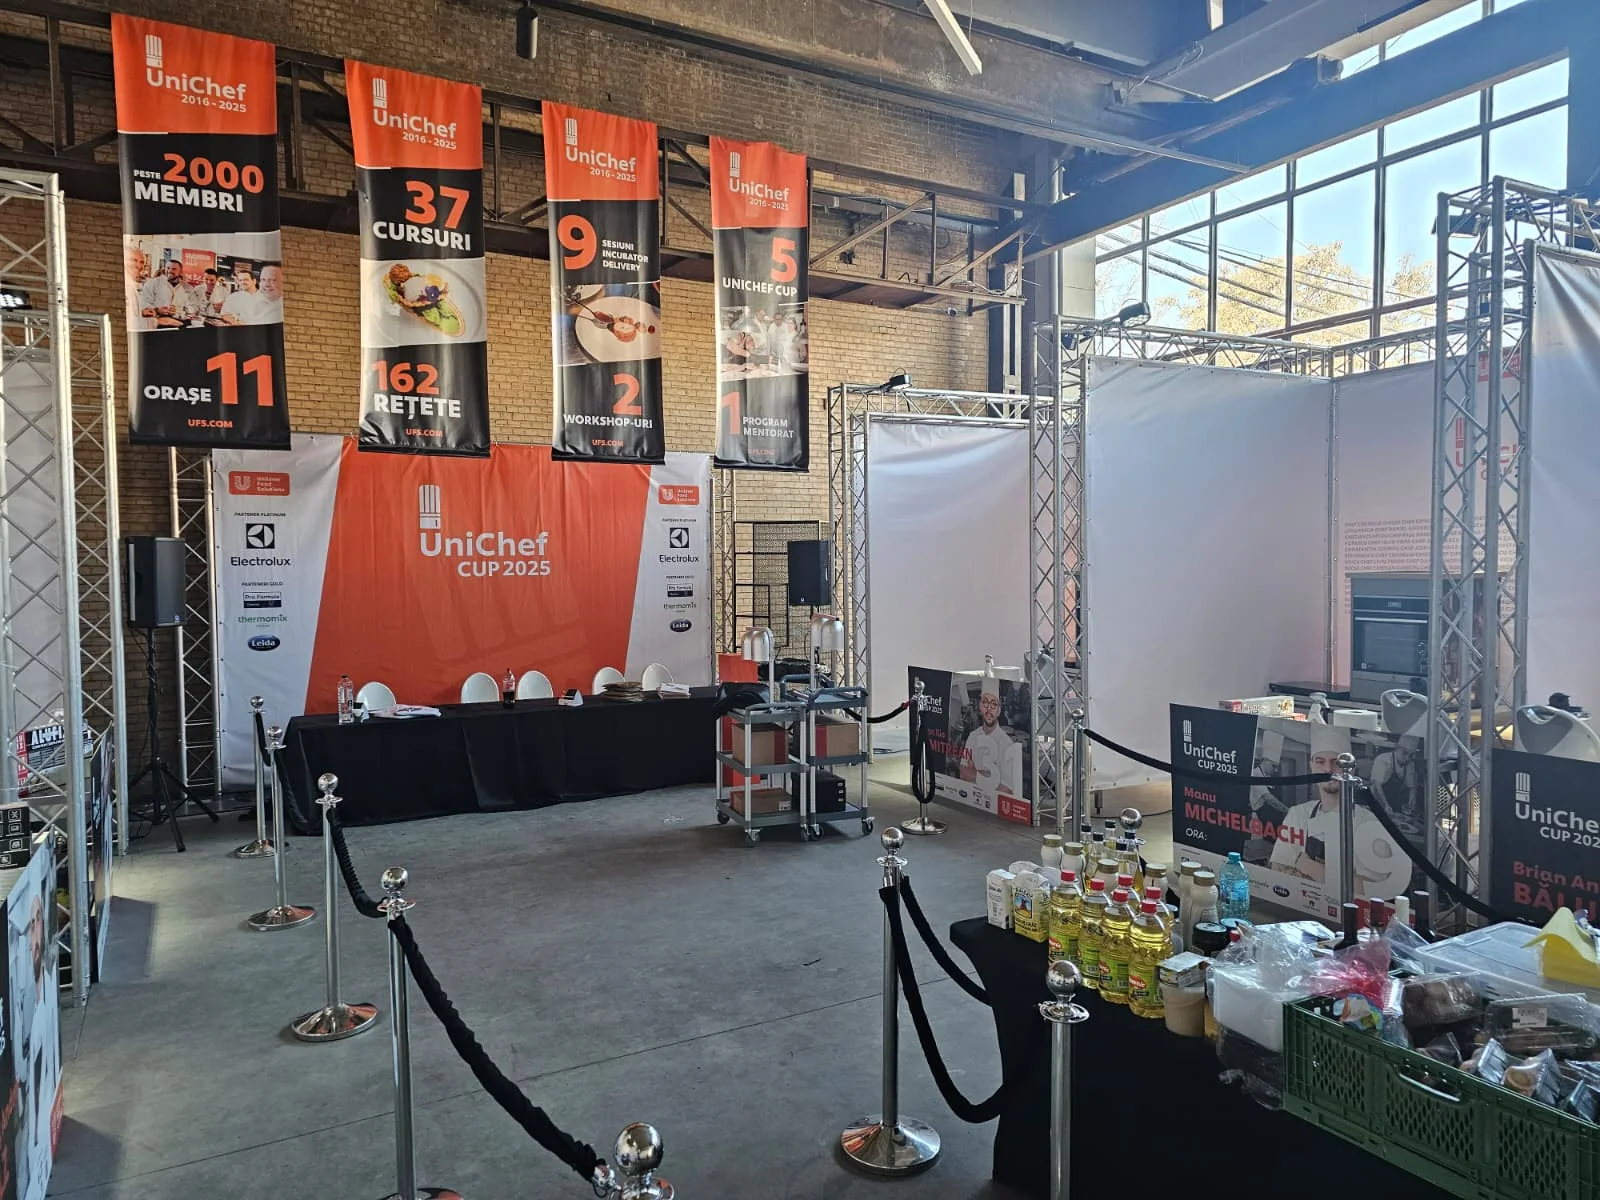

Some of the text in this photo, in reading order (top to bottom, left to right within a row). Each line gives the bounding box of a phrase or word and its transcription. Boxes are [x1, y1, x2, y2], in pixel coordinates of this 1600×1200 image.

[145, 68, 247, 101] UniChef
[181, 95, 209, 107] 2016
[219, 100, 247, 113] 2025
[372, 108, 456, 139] UniChef
[402, 131, 426, 144] 2016
[433, 138, 456, 150] 2025
[565, 147, 636, 173] UniChef
[134, 153, 264, 194] PESTE 2000
[590, 166, 610, 178] 2016
[134, 181, 243, 212] MEMBRI
[729, 178, 789, 202] UniChef
[405, 180, 470, 229] 37
[373, 221, 471, 251] CURSURI
[557, 214, 597, 271] 9
[602, 240, 634, 251] SESIUNI
[602, 249, 648, 263] INCUBATOR
[770, 236, 797, 283] 5
[603, 260, 641, 272] DELIVERY
[722, 277, 798, 297] UNICHEF CUP
[206, 352, 274, 407] 11
[371, 360, 441, 395] 162
[612, 373, 643, 416] 2
[562, 414, 654, 429] WORKSHOP-URI
[721, 391, 741, 434] 1
[743, 416, 789, 428] PROGRAM
[187, 418, 233, 428] UFS.COM
[406, 428, 443, 438] UFS.COM
[743, 427, 795, 439] MENTORAT
[592, 439, 624, 448] UFS.COM
[420, 531, 549, 557] UniChef
[230, 556, 291, 567] Electrolux
[659, 554, 699, 564] Electrolux
[457, 561, 551, 577] CUP 2025
[238, 614, 288, 624] thermomix
[31, 726, 65, 747] ALUFI
[1183, 742, 1237, 764] UniChef
[1197, 759, 1238, 775] CUP 2025
[1183, 786, 1217, 804] Manu
[1184, 802, 1305, 847] MICHELBACH
[1185, 827, 1208, 841] ORA:
[1540, 827, 1571, 842] CUP
[1513, 860, 1567, 886] Brian
